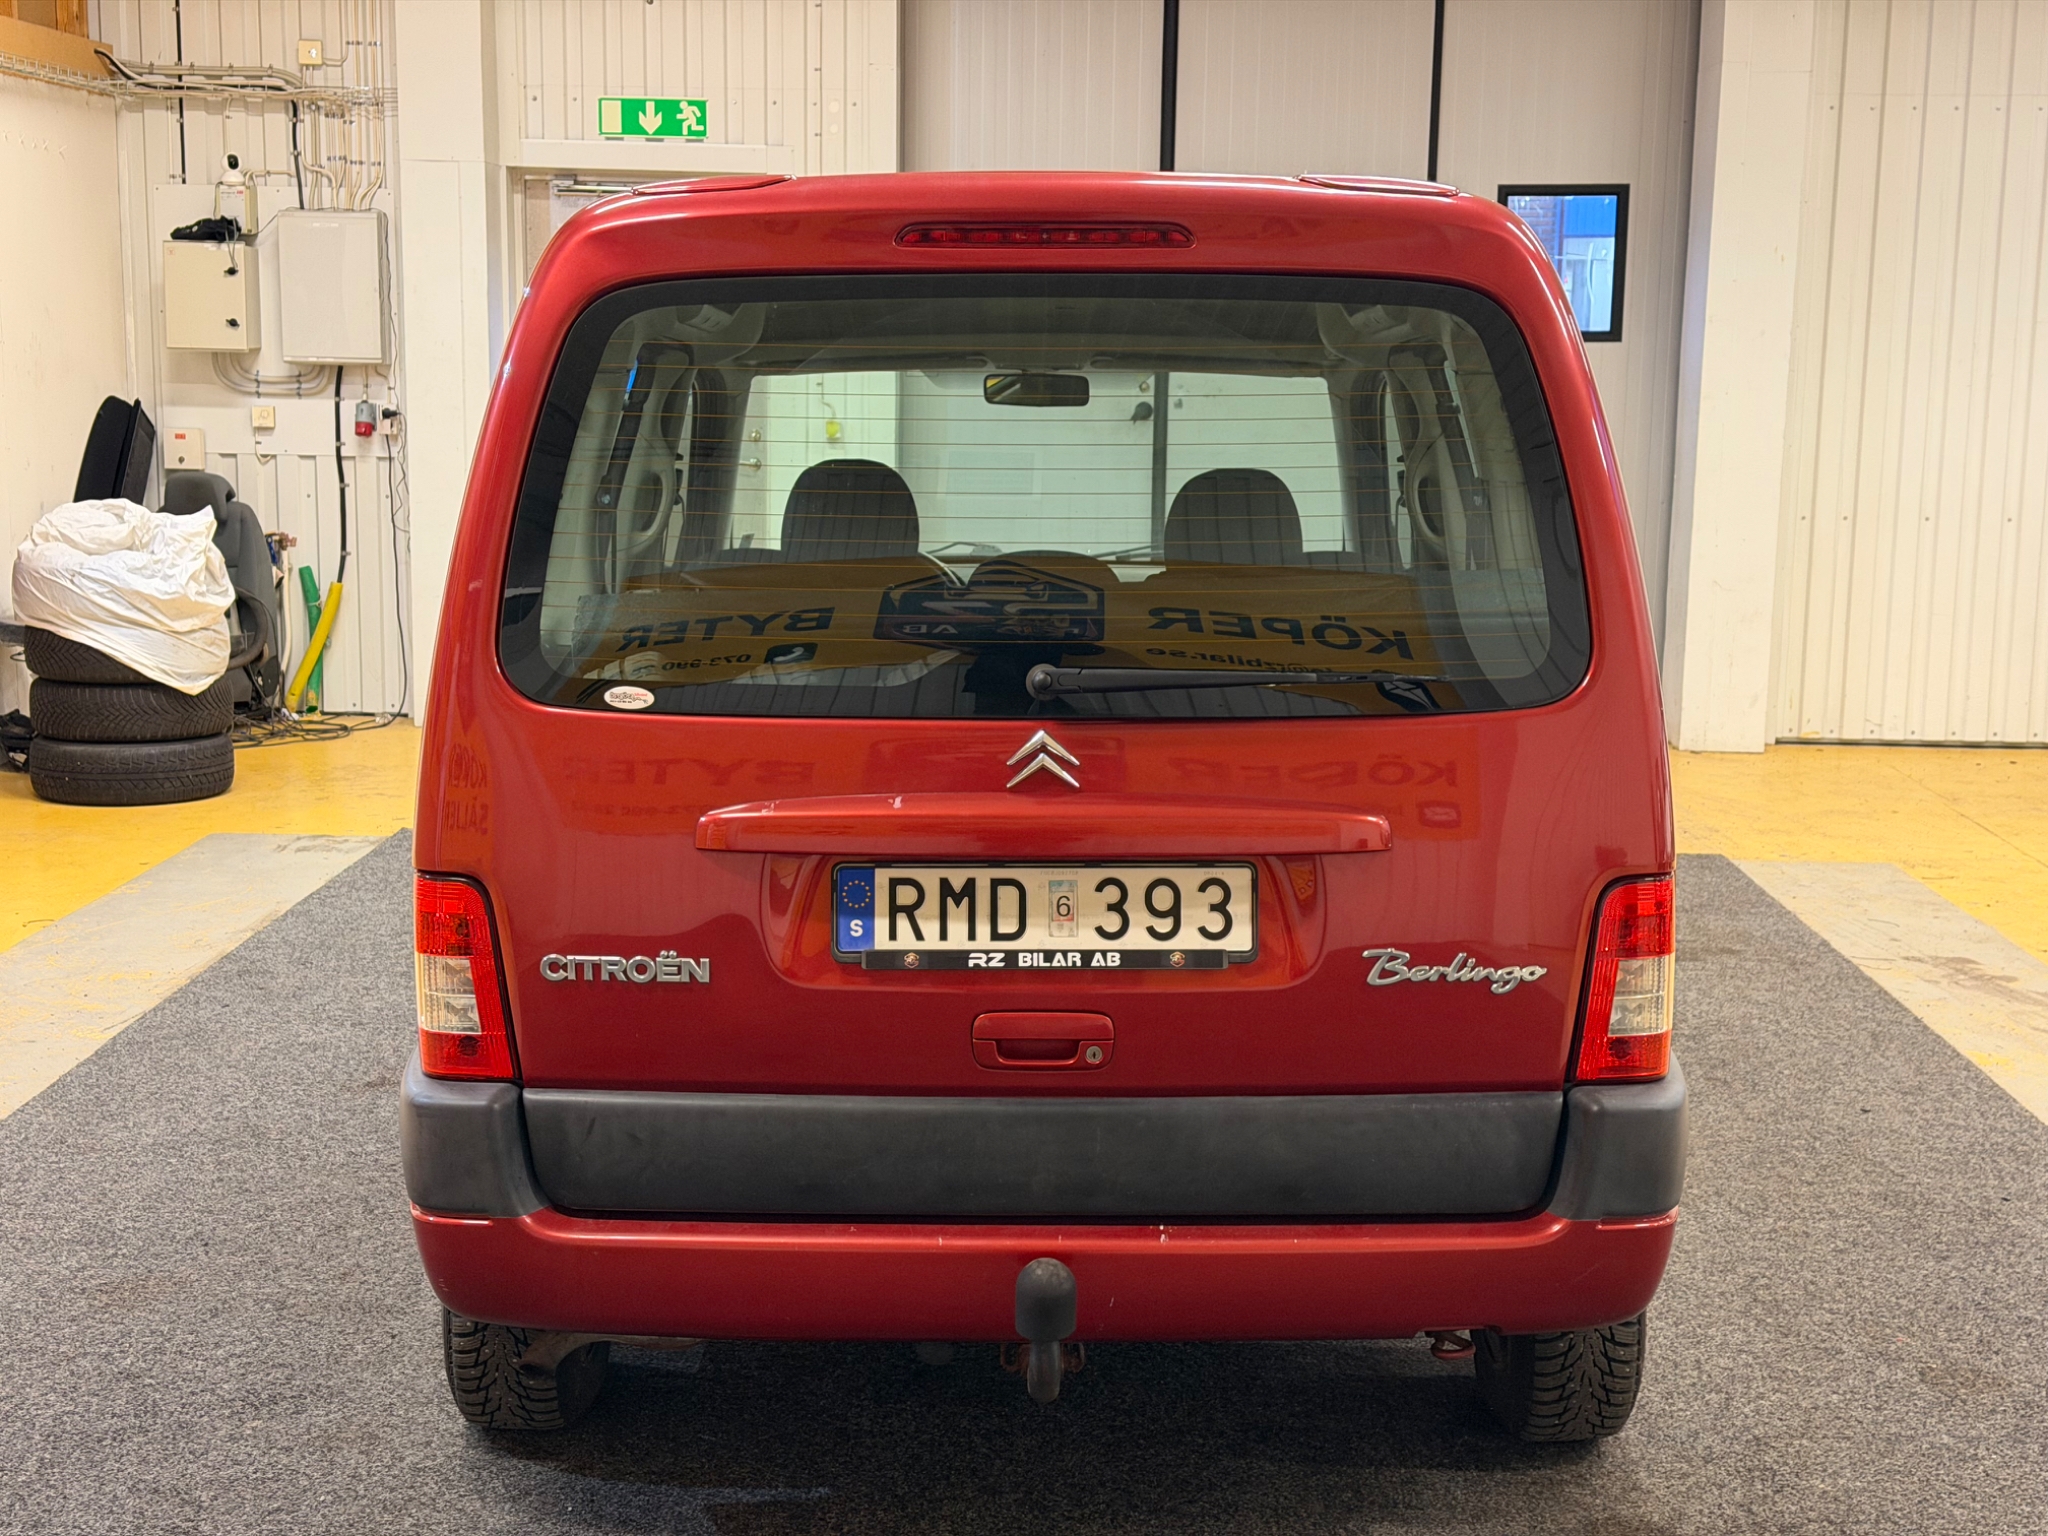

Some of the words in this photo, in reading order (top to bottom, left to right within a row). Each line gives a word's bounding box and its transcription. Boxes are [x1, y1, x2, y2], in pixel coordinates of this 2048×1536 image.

[888, 877, 1028, 942] RMD
[1094, 877, 1233, 941] 393
[1055, 895, 1071, 917] 6
[850, 919, 863, 937] S
[539, 950, 710, 984] CITROËN
[968, 953, 1006, 967] RZ
[1018, 952, 1082, 967] BILAR
[1090, 952, 1121, 967] AB
[1361, 948, 1547, 994] Berlingo
